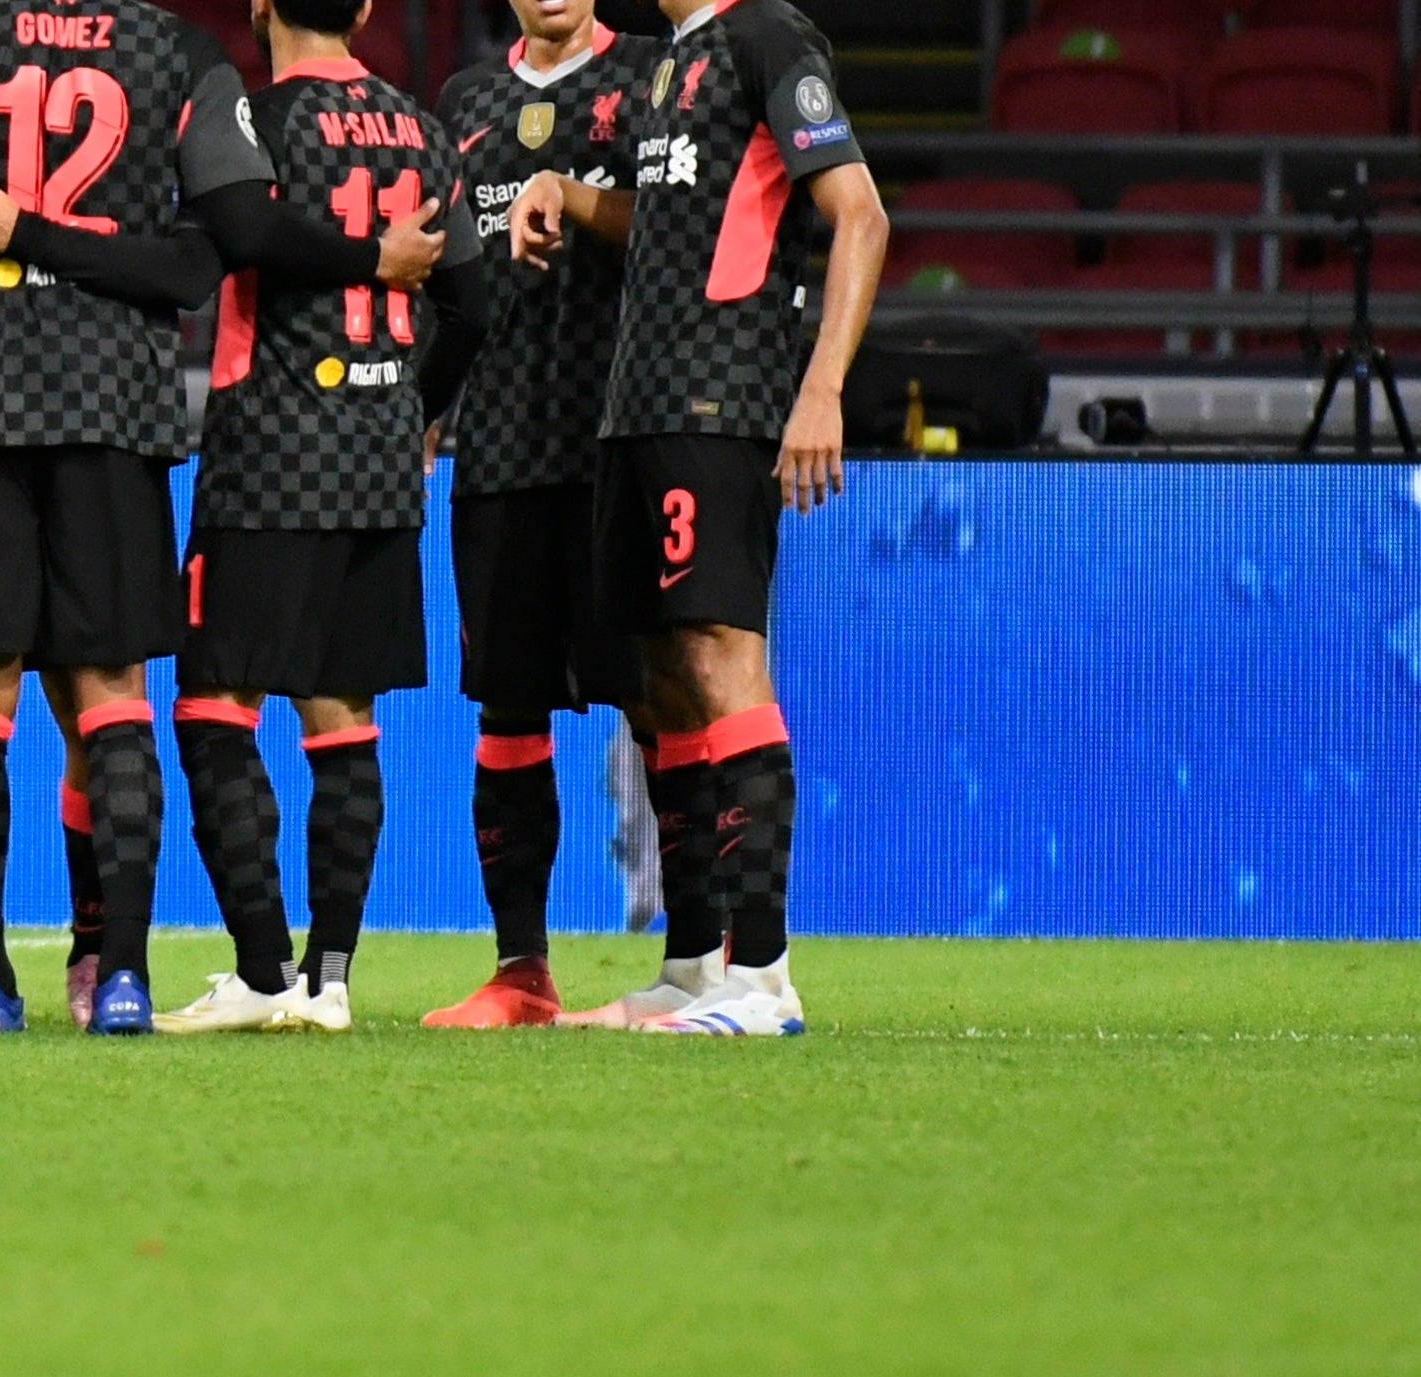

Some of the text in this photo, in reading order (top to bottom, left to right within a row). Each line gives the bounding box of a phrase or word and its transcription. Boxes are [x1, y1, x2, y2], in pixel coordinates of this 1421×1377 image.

[16, 11, 114, 49] GOMEZ
[810, 124, 849, 141] RESPECT
[330, 166, 422, 345] 11
[347, 362, 383, 386] RIGHT
[663, 488, 696, 562] 3
[108, 1001, 141, 1012] COPA
